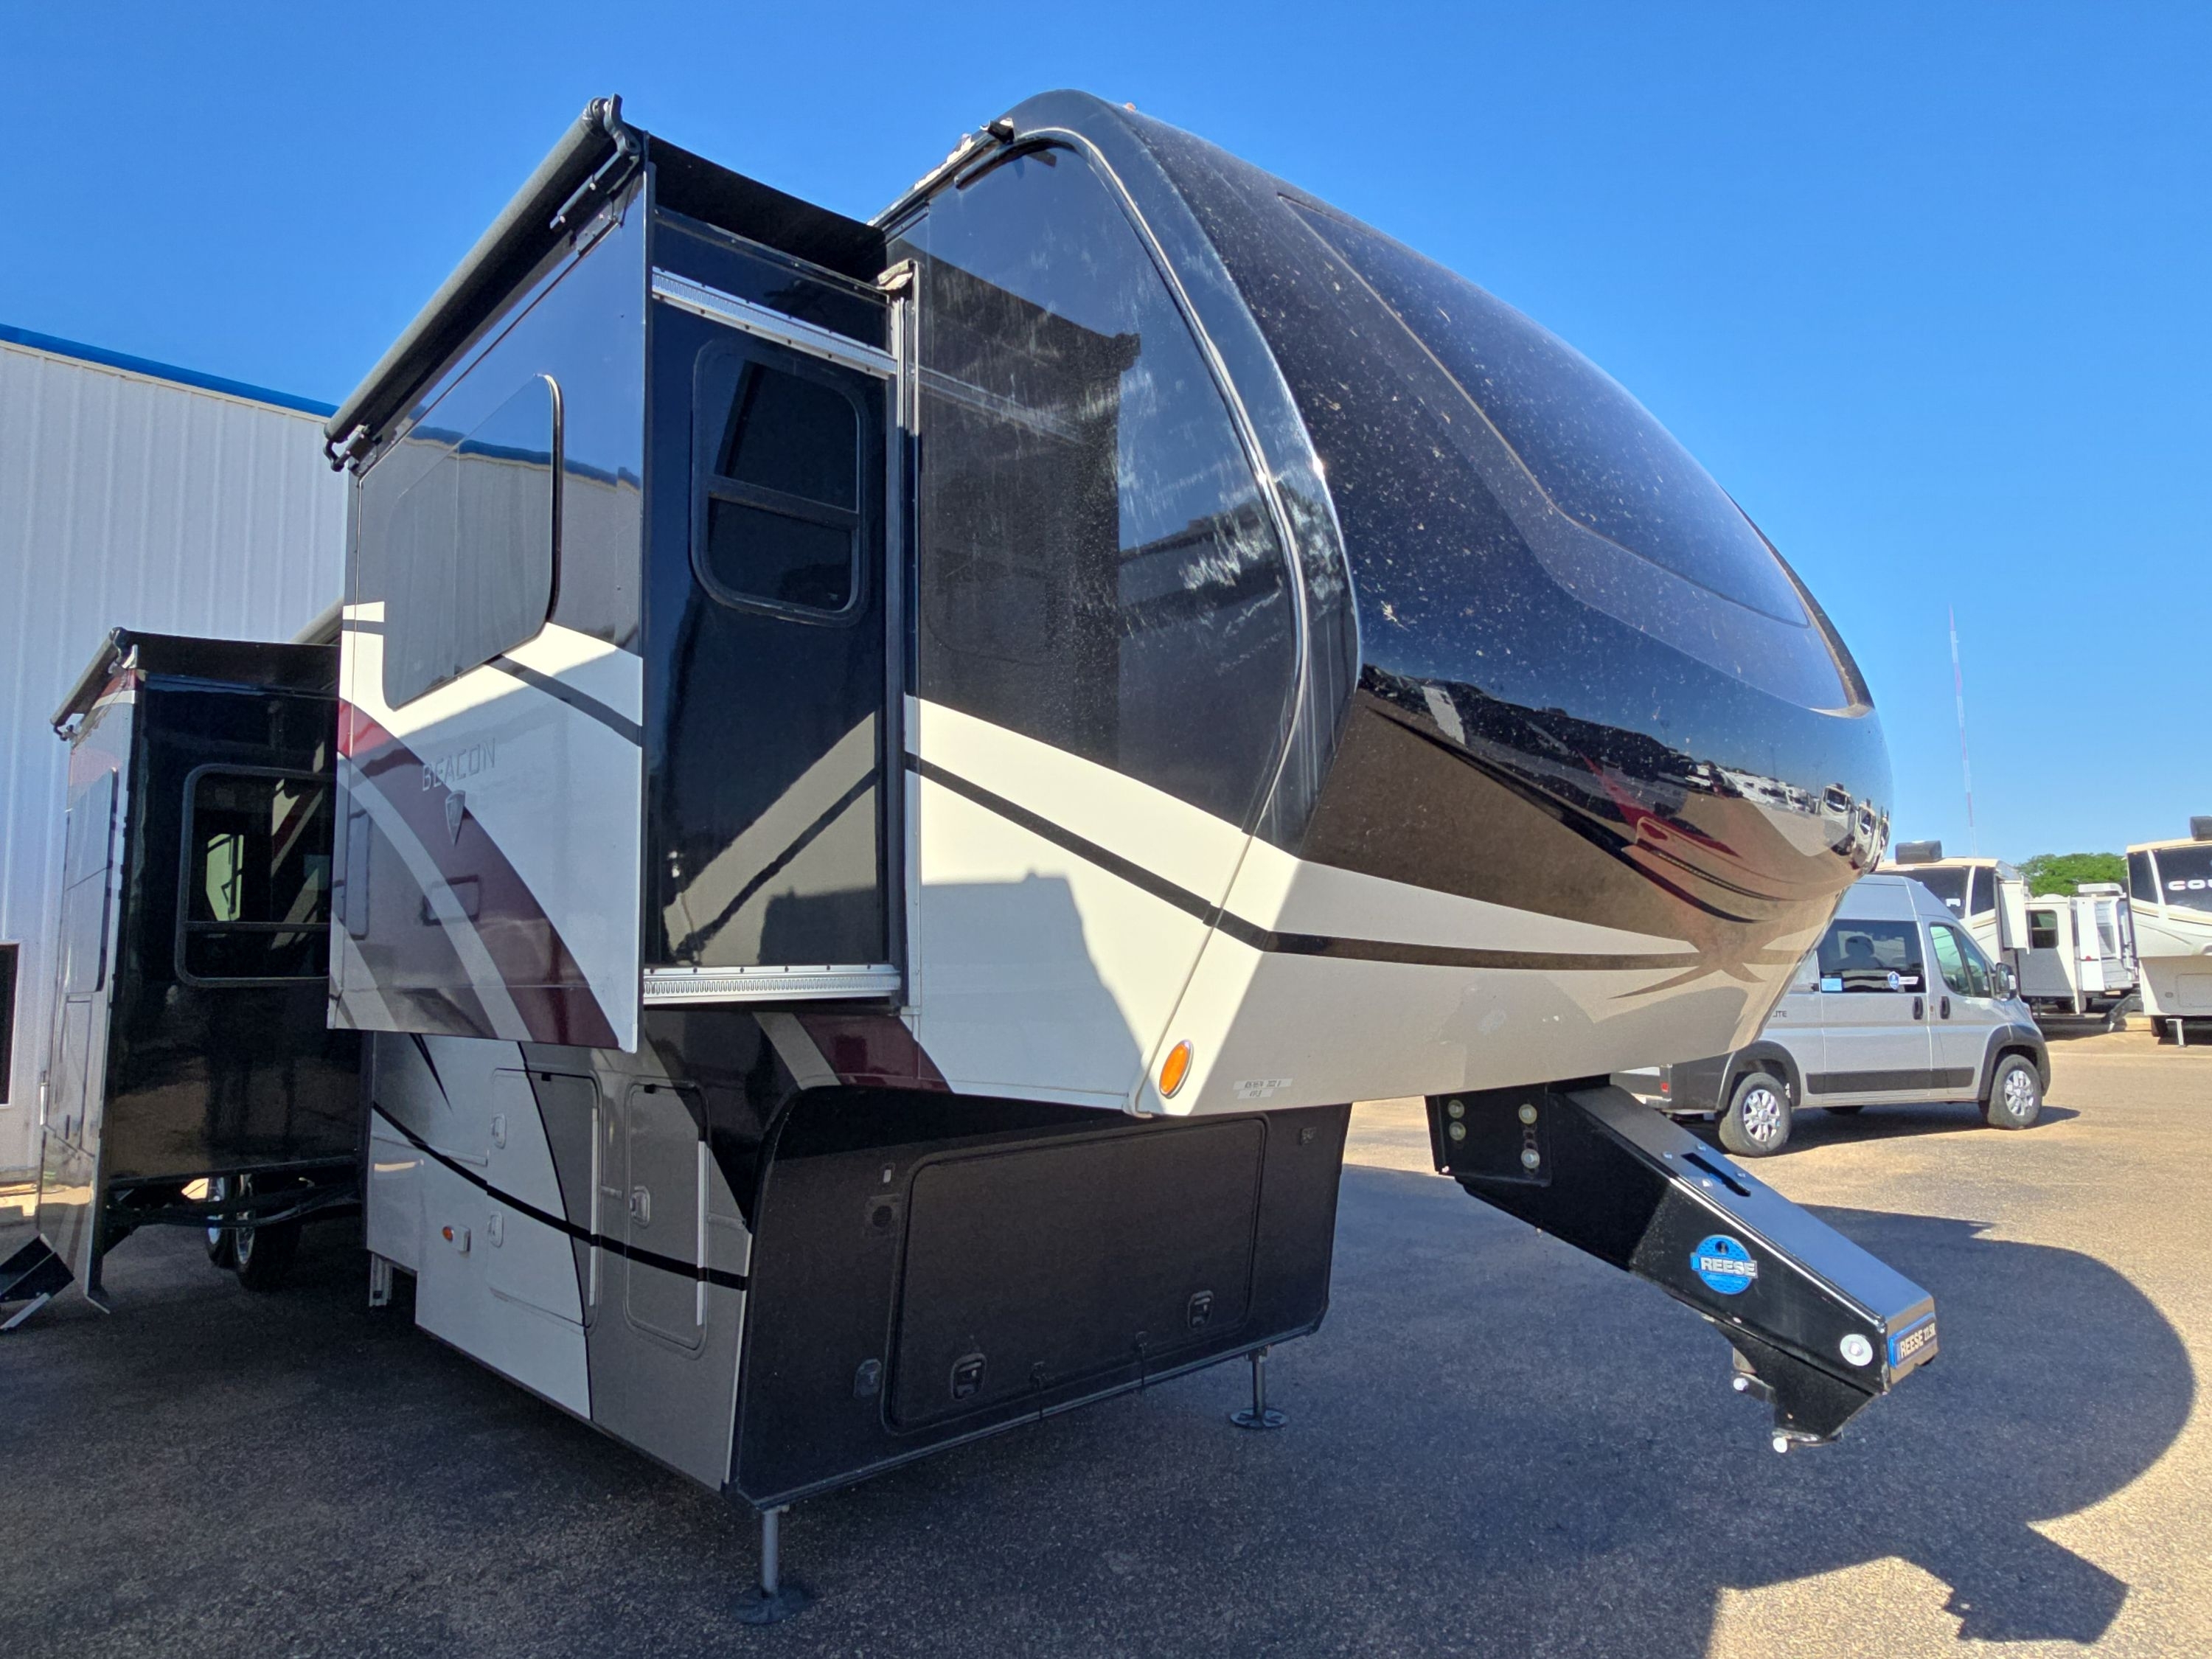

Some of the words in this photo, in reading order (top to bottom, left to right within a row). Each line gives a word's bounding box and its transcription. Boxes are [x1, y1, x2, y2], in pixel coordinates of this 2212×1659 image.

[422, 738, 495, 792] BEACON
[2168, 879, 2212, 891] CO
[1700, 1257, 1756, 1277] REESE
[1900, 1329, 1924, 1359] REESE
